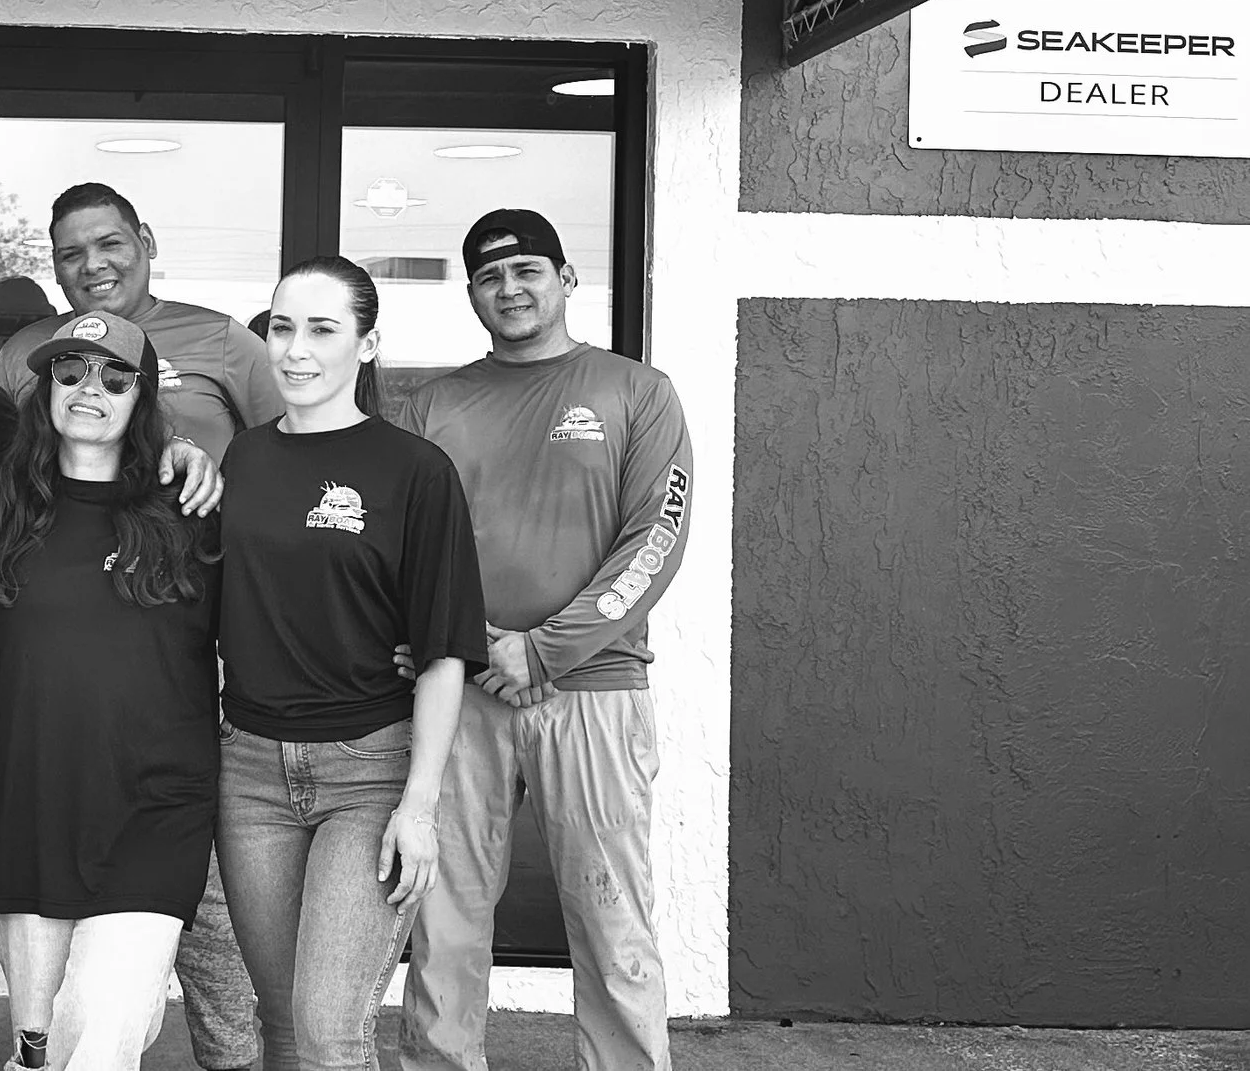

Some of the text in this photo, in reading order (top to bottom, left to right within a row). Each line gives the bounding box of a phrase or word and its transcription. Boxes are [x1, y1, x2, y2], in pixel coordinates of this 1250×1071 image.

[1017, 30, 1236, 57] SEAKEEPER
[1040, 81, 1169, 106] DEALER
[551, 431, 569, 440] RAY
[596, 464, 689, 621] RAY BOATS
